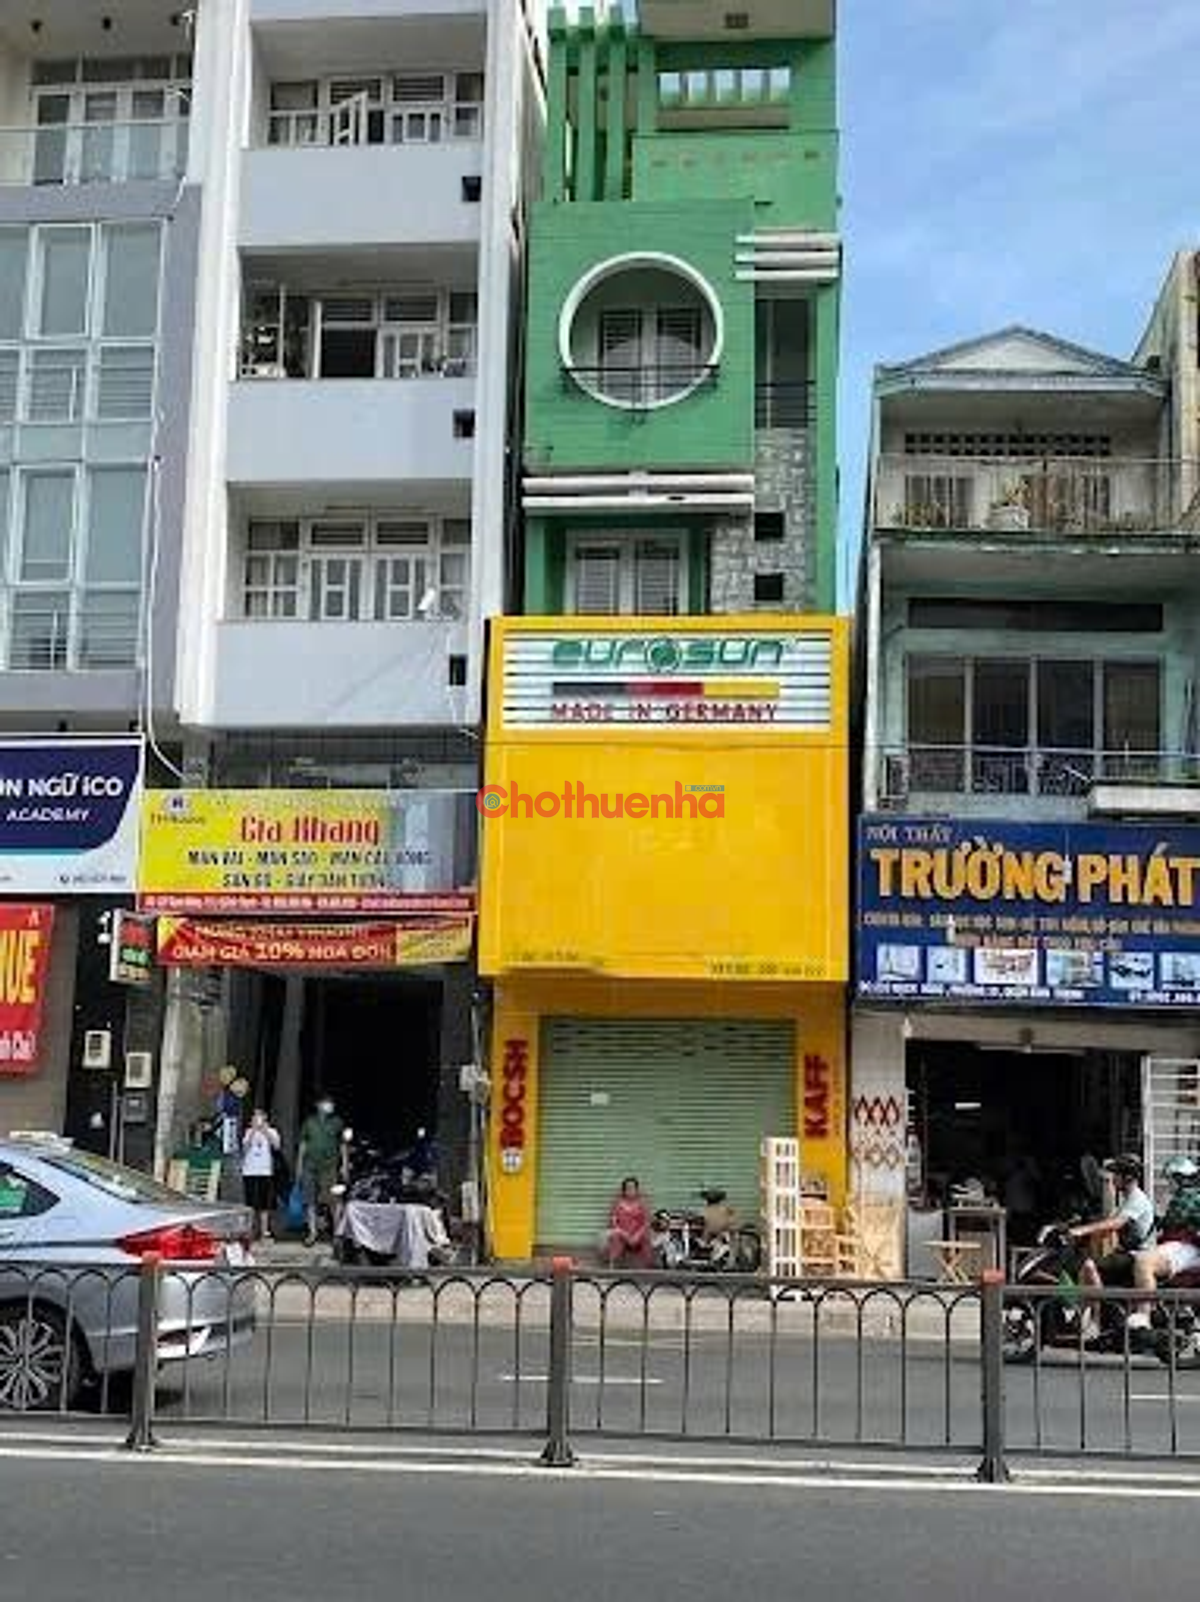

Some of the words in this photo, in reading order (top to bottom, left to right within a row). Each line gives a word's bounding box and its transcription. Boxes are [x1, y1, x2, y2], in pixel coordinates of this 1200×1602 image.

[552, 703, 612, 721] MADE
[629, 703, 651, 721] IN
[665, 703, 777, 721] GERMANY
[82, 776, 123, 796] ICO
[6, 807, 89, 821] ACADEMY
[870, 835, 1065, 902] TRƯỜNG
[1077, 841, 1200, 906] PHÁT
